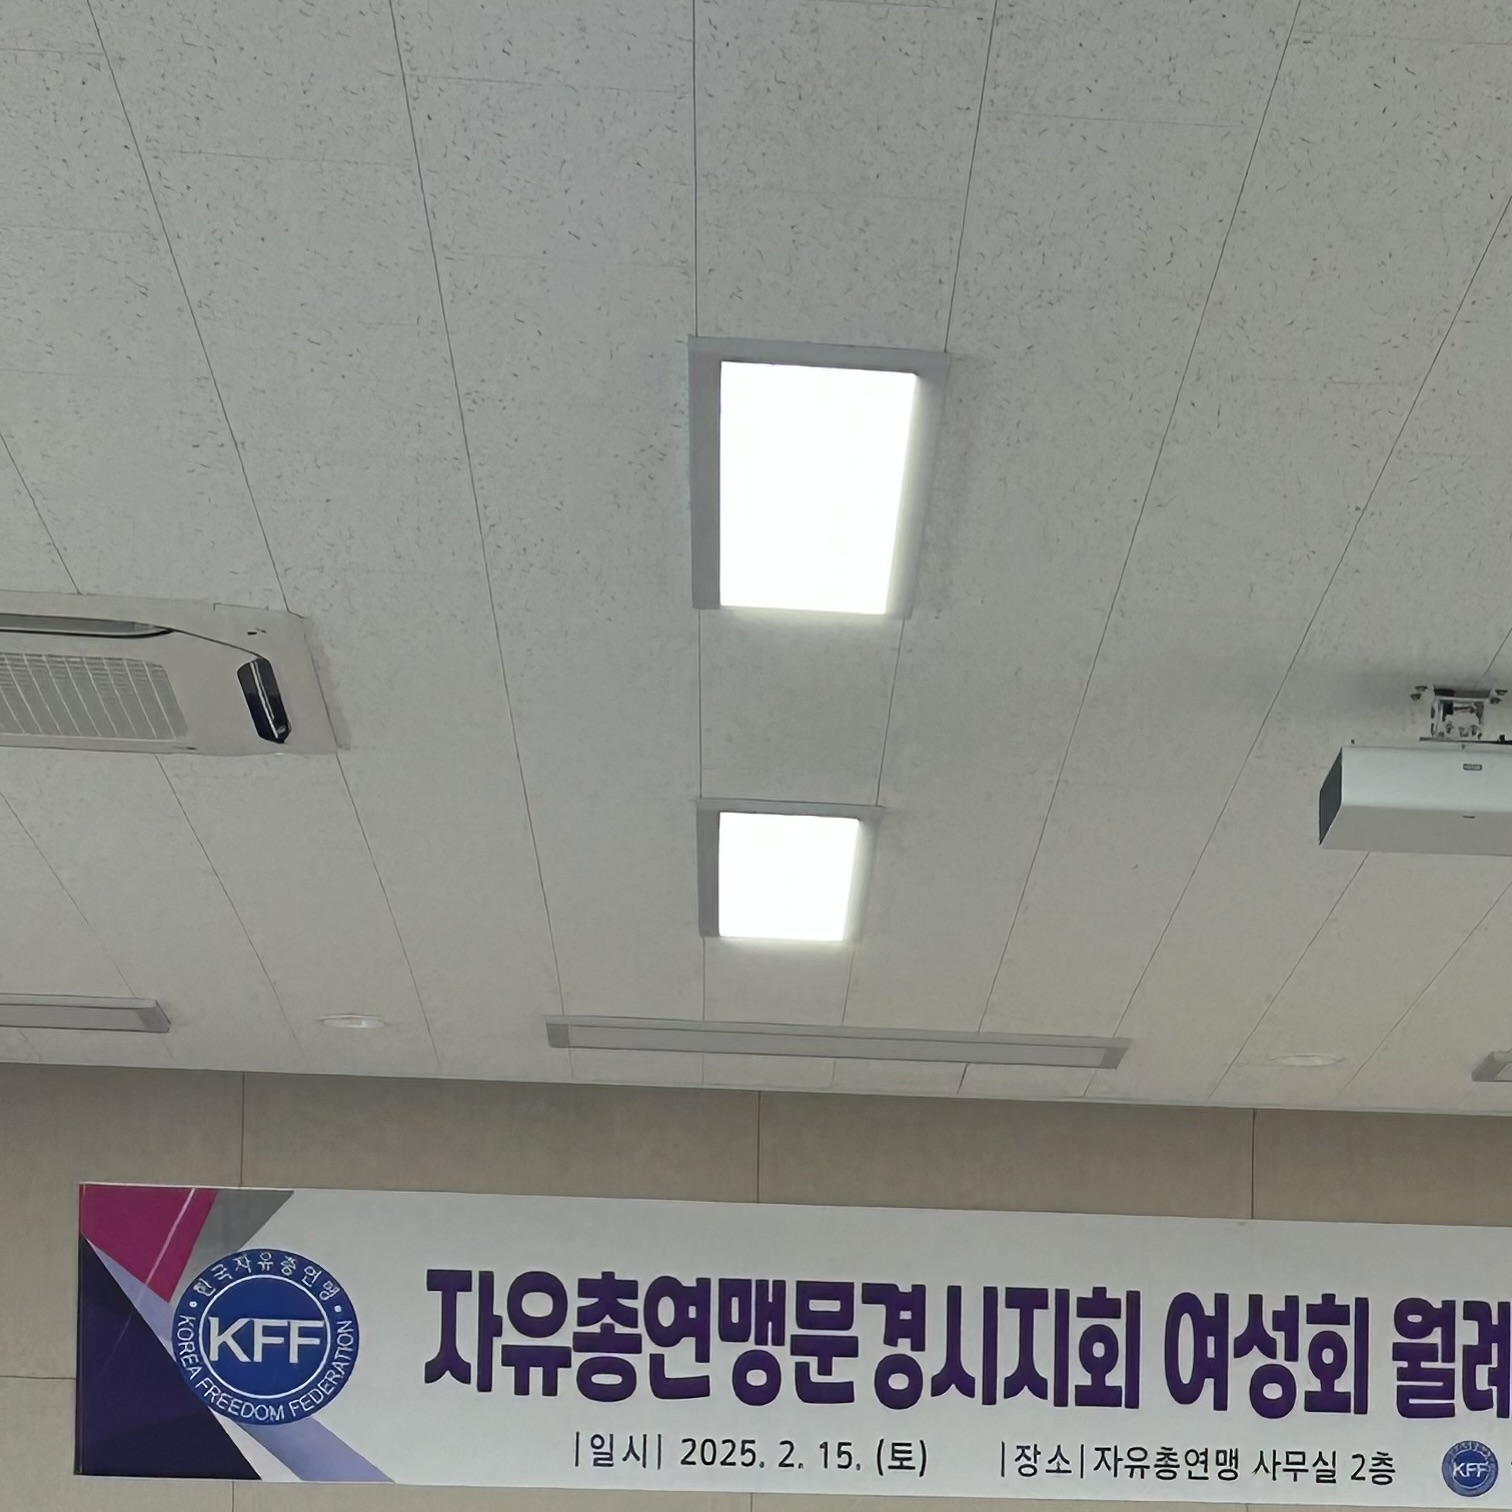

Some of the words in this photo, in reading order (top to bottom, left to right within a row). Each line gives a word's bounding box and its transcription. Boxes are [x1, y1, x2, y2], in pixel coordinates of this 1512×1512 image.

[208, 1316, 325, 1364] KFF
[1165, 1292, 1369, 1419] 여성회
[176, 1315, 202, 1380] KOREA
[194, 1378, 285, 1422] FREEDOM
[288, 1320, 354, 1418] FEDERATION
[681, 1438, 764, 1468] 2025.
[779, 1440, 803, 1468] 2.
[820, 1442, 860, 1470] 15.
[877, 1439, 926, 1477] (토)
[1094, 1445, 1238, 1481] 자유총연맹
[1253, 1450, 1336, 1483] 사무실
[1351, 1452, 1395, 1485] 2층
[1453, 1461, 1489, 1478] KFF
